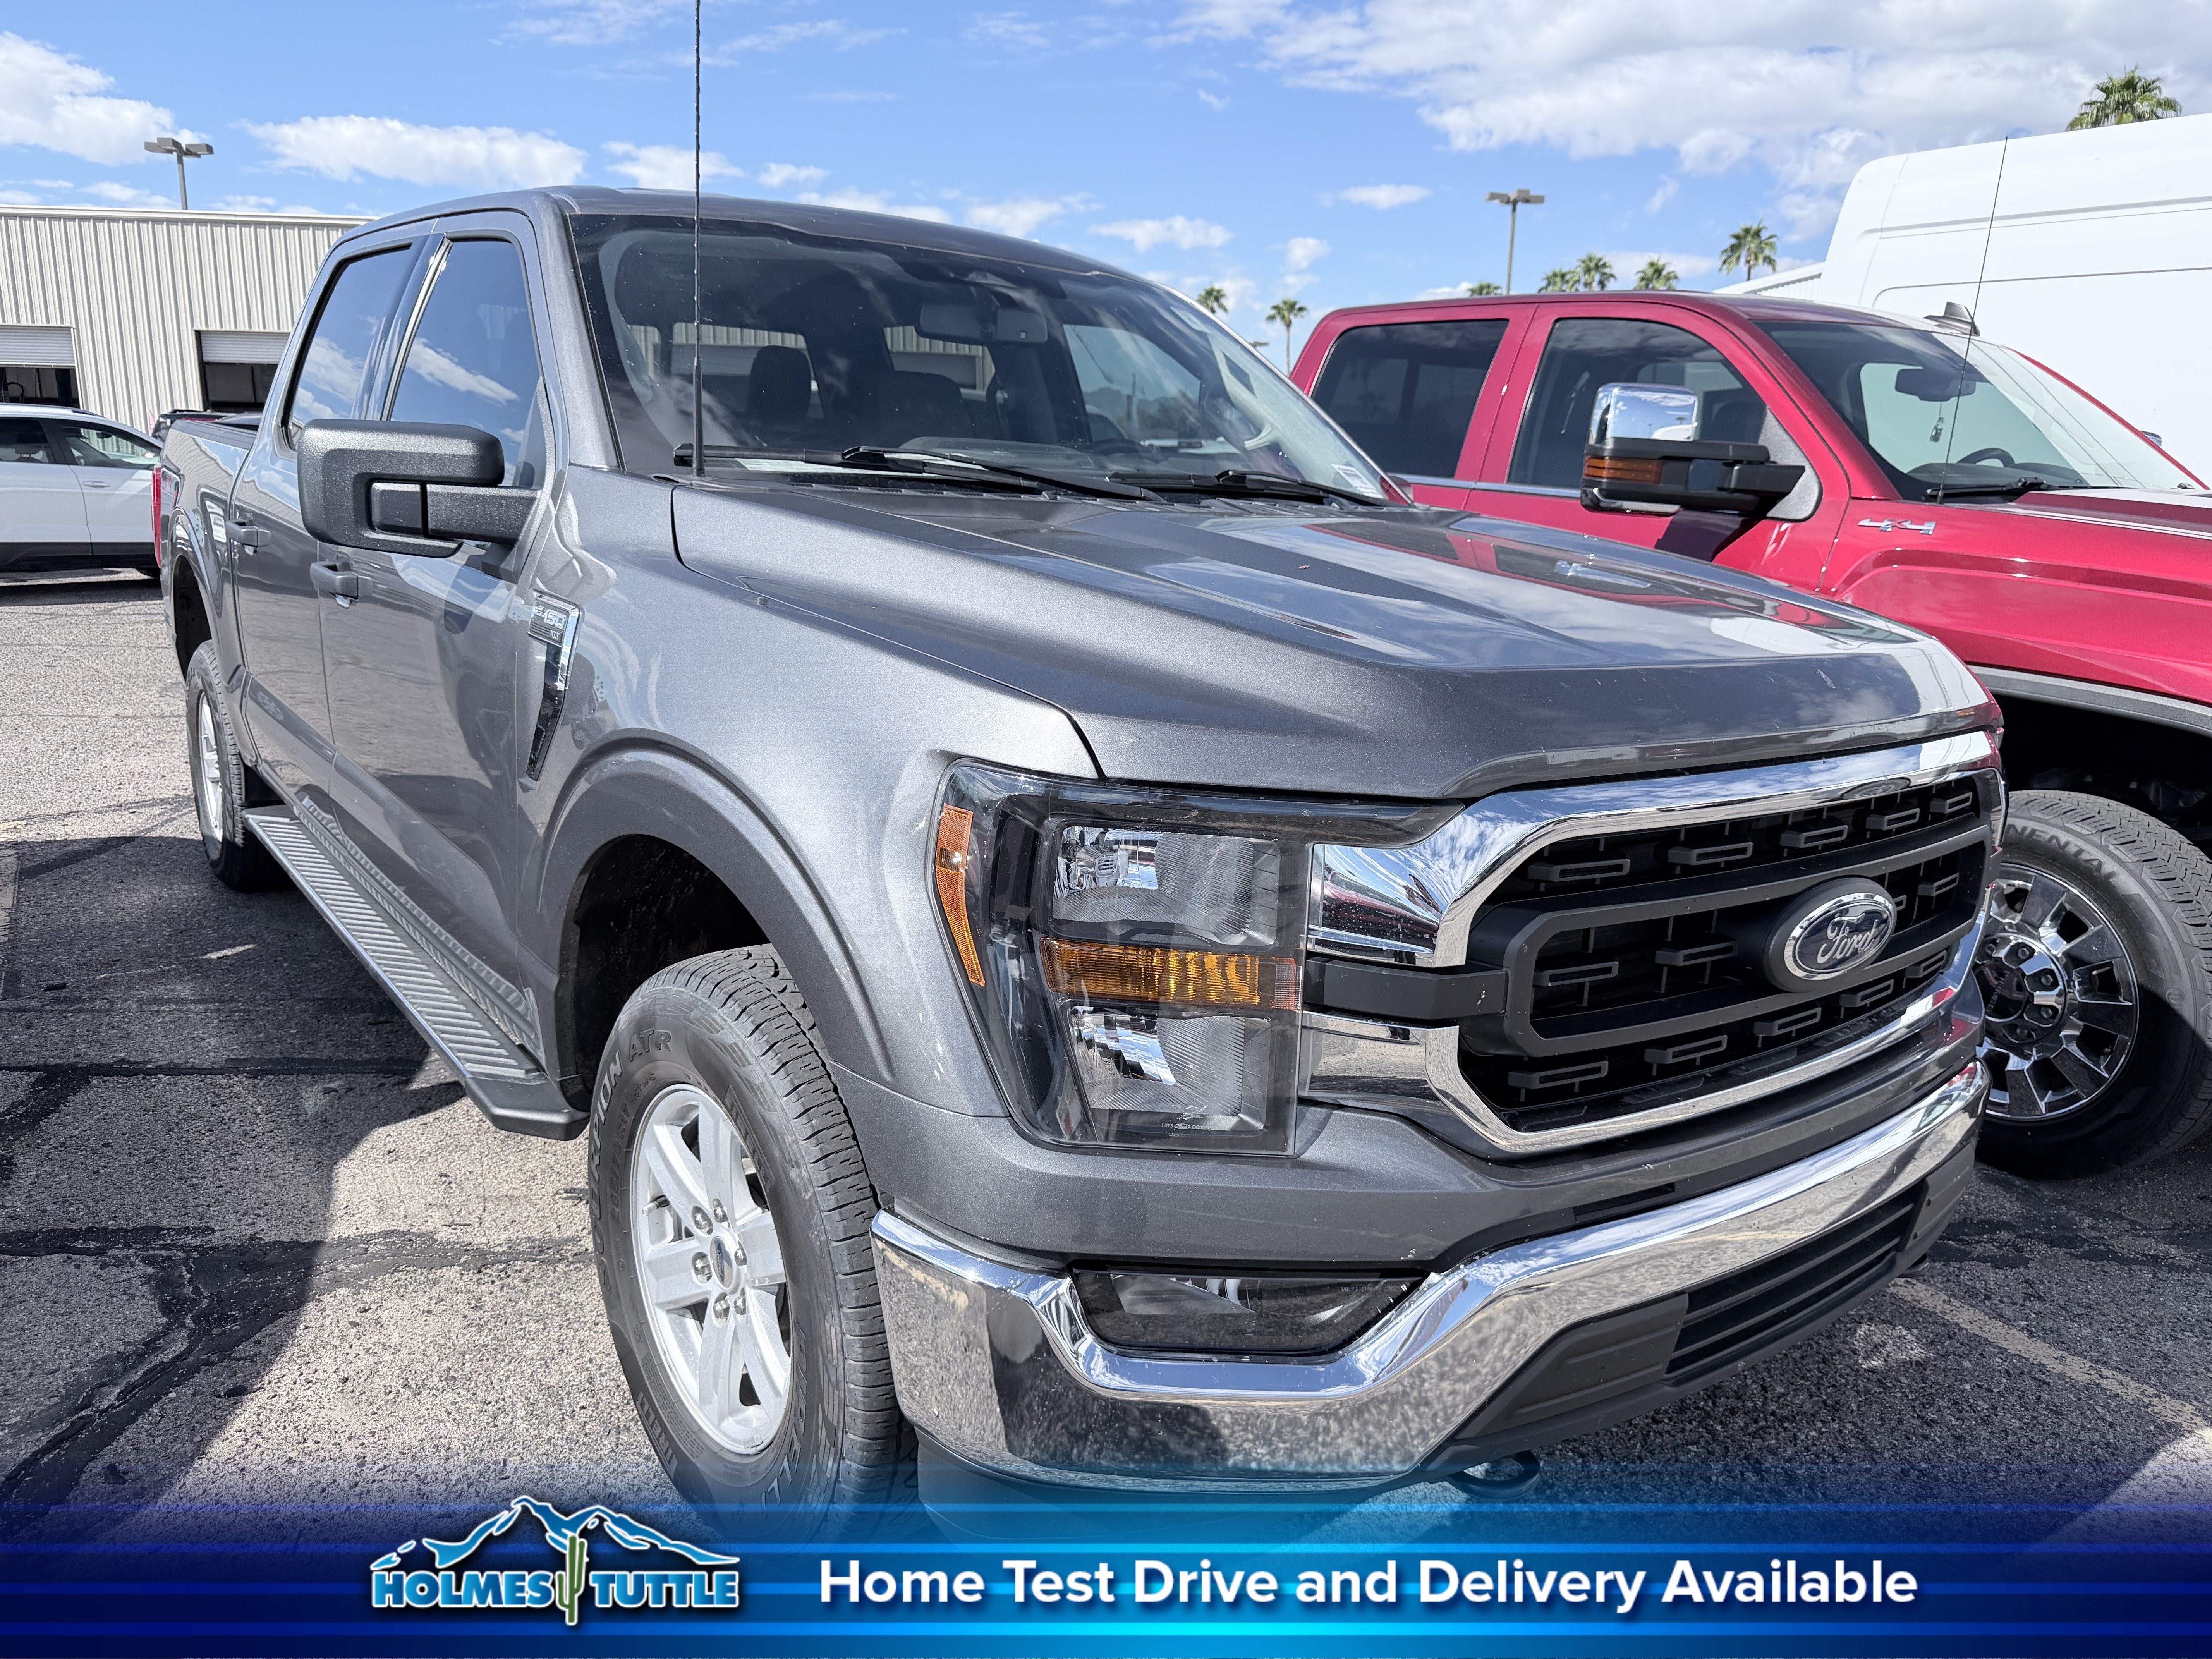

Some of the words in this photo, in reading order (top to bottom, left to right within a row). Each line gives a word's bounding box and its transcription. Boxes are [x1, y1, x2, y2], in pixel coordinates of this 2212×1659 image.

[550, 630, 561, 641] XLT
[2005, 823, 2121, 888] NENTAL
[1817, 912, 1879, 965] Ford
[591, 1049, 623, 1291] SCORPION
[629, 1027, 672, 1063] ATR
[725, 1085, 775, 1194] PIRELLI
[636, 1391, 678, 1479] PIRELLI
[761, 1317, 807, 1518] PIRELLI
